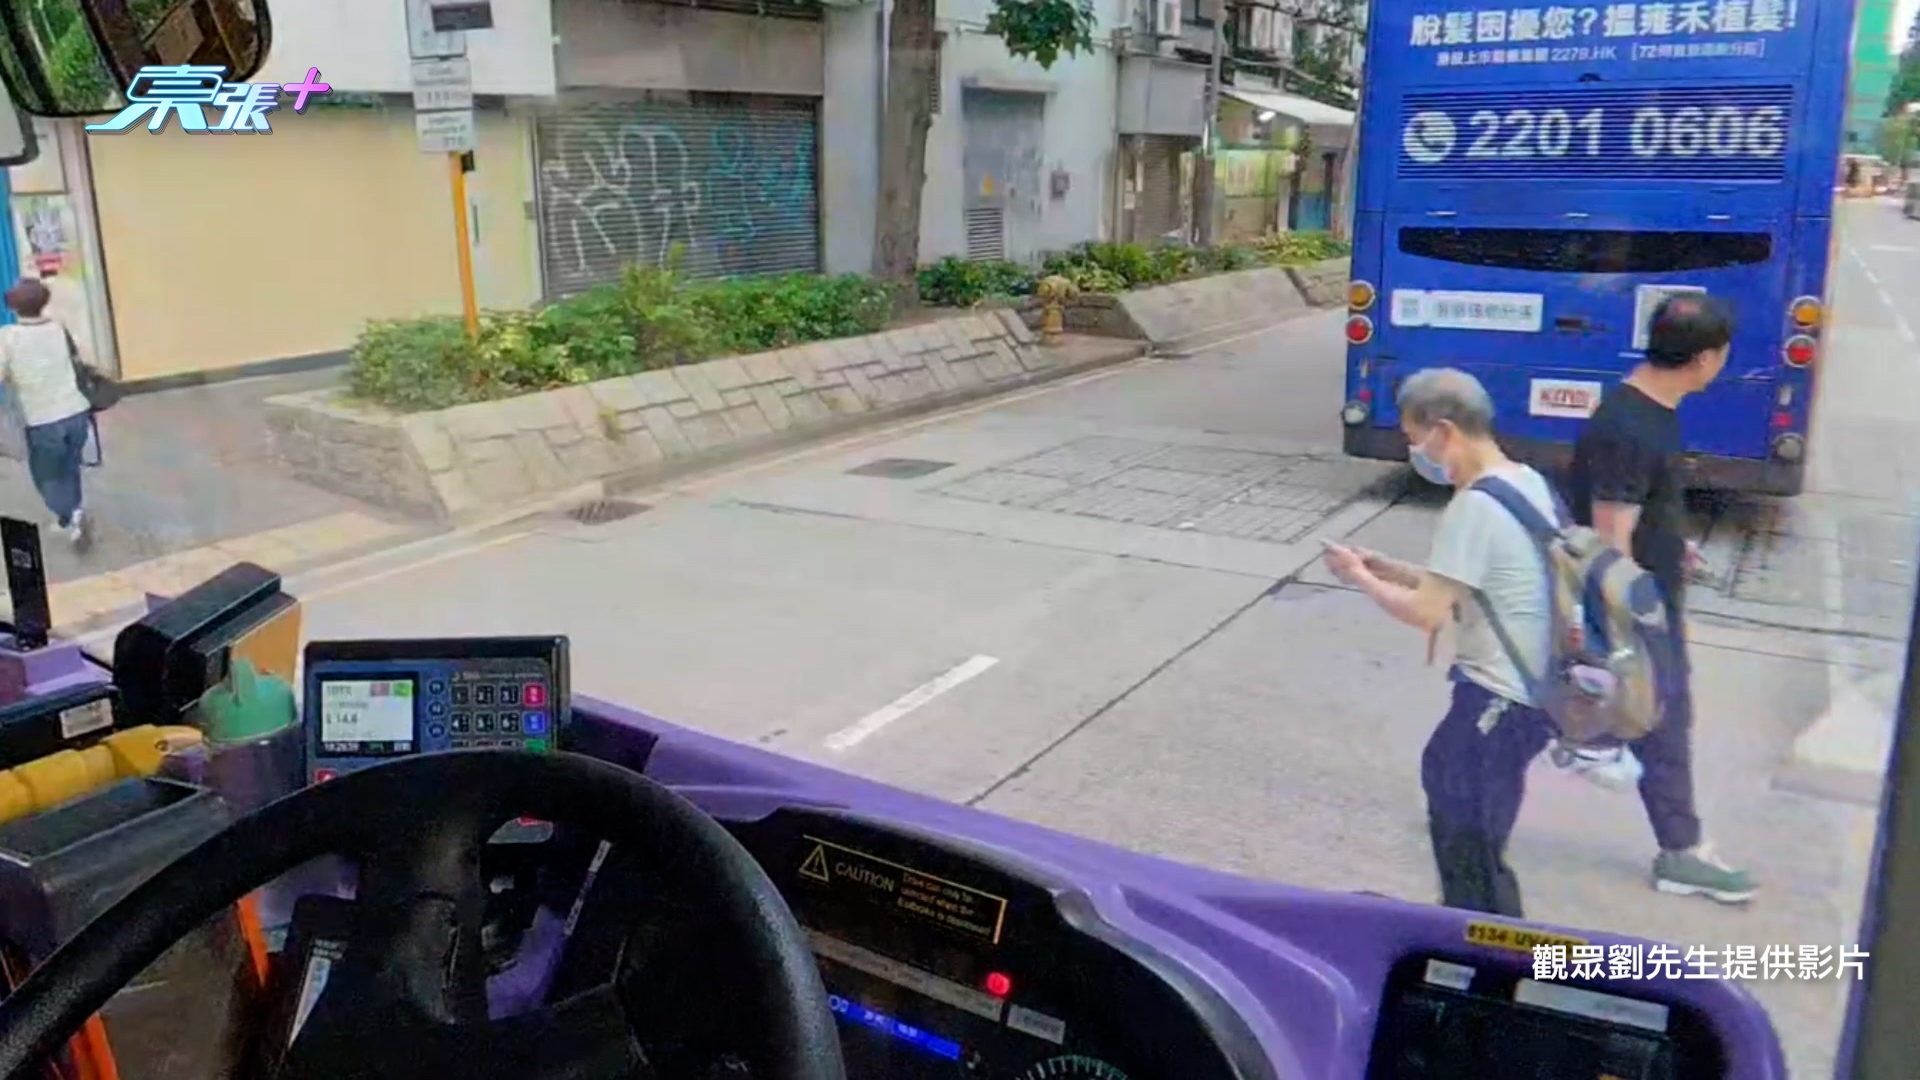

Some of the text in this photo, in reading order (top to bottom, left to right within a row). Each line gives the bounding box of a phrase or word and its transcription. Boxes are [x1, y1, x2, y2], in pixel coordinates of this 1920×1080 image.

[1551, 45, 1617, 62] 2279.HK
[1466, 104, 1784, 159] 2201 0606
[835, 862, 896, 893] CAUTION
